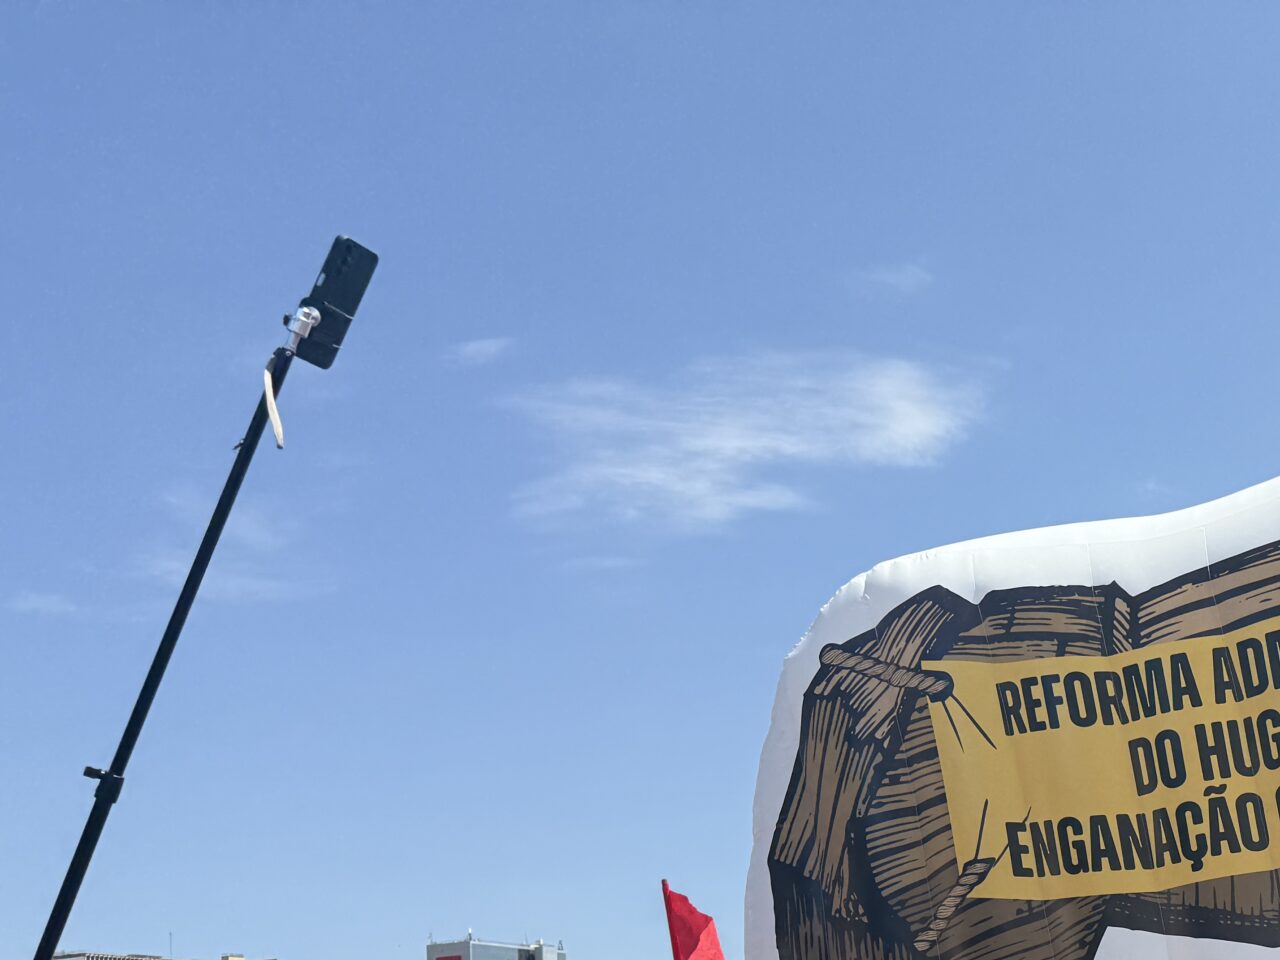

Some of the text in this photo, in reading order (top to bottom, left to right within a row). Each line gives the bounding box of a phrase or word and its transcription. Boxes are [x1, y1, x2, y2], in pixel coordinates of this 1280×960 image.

[996, 653, 1202, 737] REFORMA
[1128, 728, 1186, 797] DO
[1005, 783, 1270, 878] ENGANAÇÃO
